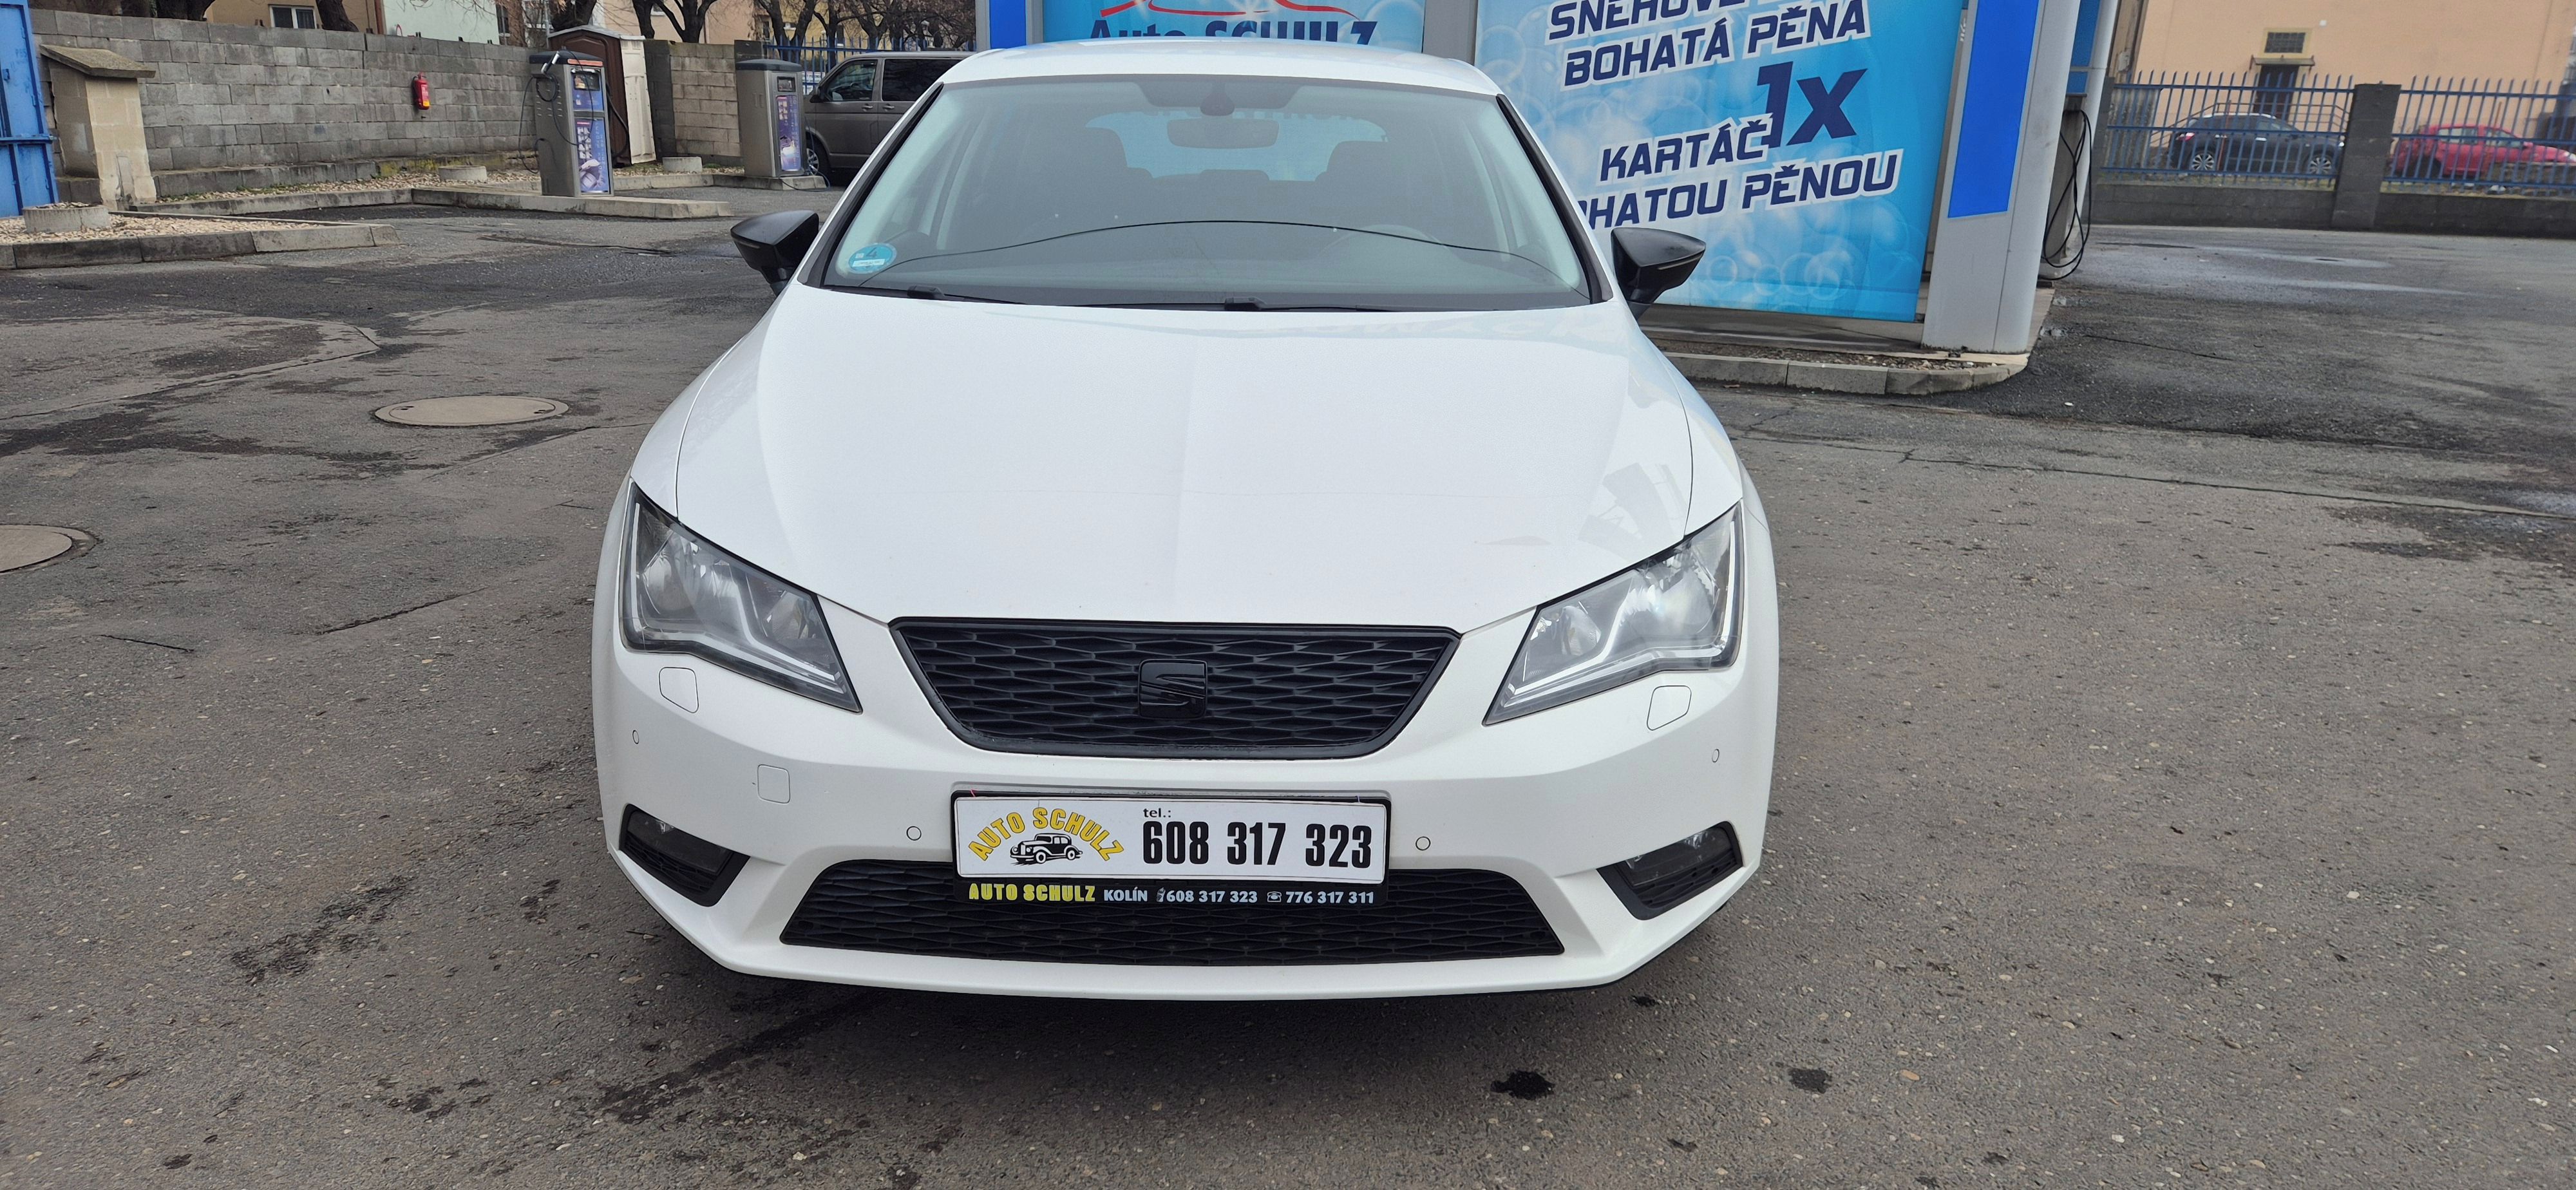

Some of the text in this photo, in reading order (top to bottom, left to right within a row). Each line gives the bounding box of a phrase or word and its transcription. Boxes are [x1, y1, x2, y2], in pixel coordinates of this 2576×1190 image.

[1564, 0, 1866, 86] BOHATÁ PĚNA
[1600, 119, 1767, 182] KARTÁČ
[1578, 154, 1897, 230] HATOU PĚNOU
[969, 807, 1124, 862] AUTO SCHULZ
[1142, 808, 1171, 818] tel.:
[1142, 821, 1372, 869] 608 317 323
[969, 883, 1374, 904] AUTO SCHULZ KOLÍN 608 317 323 776 317 311
